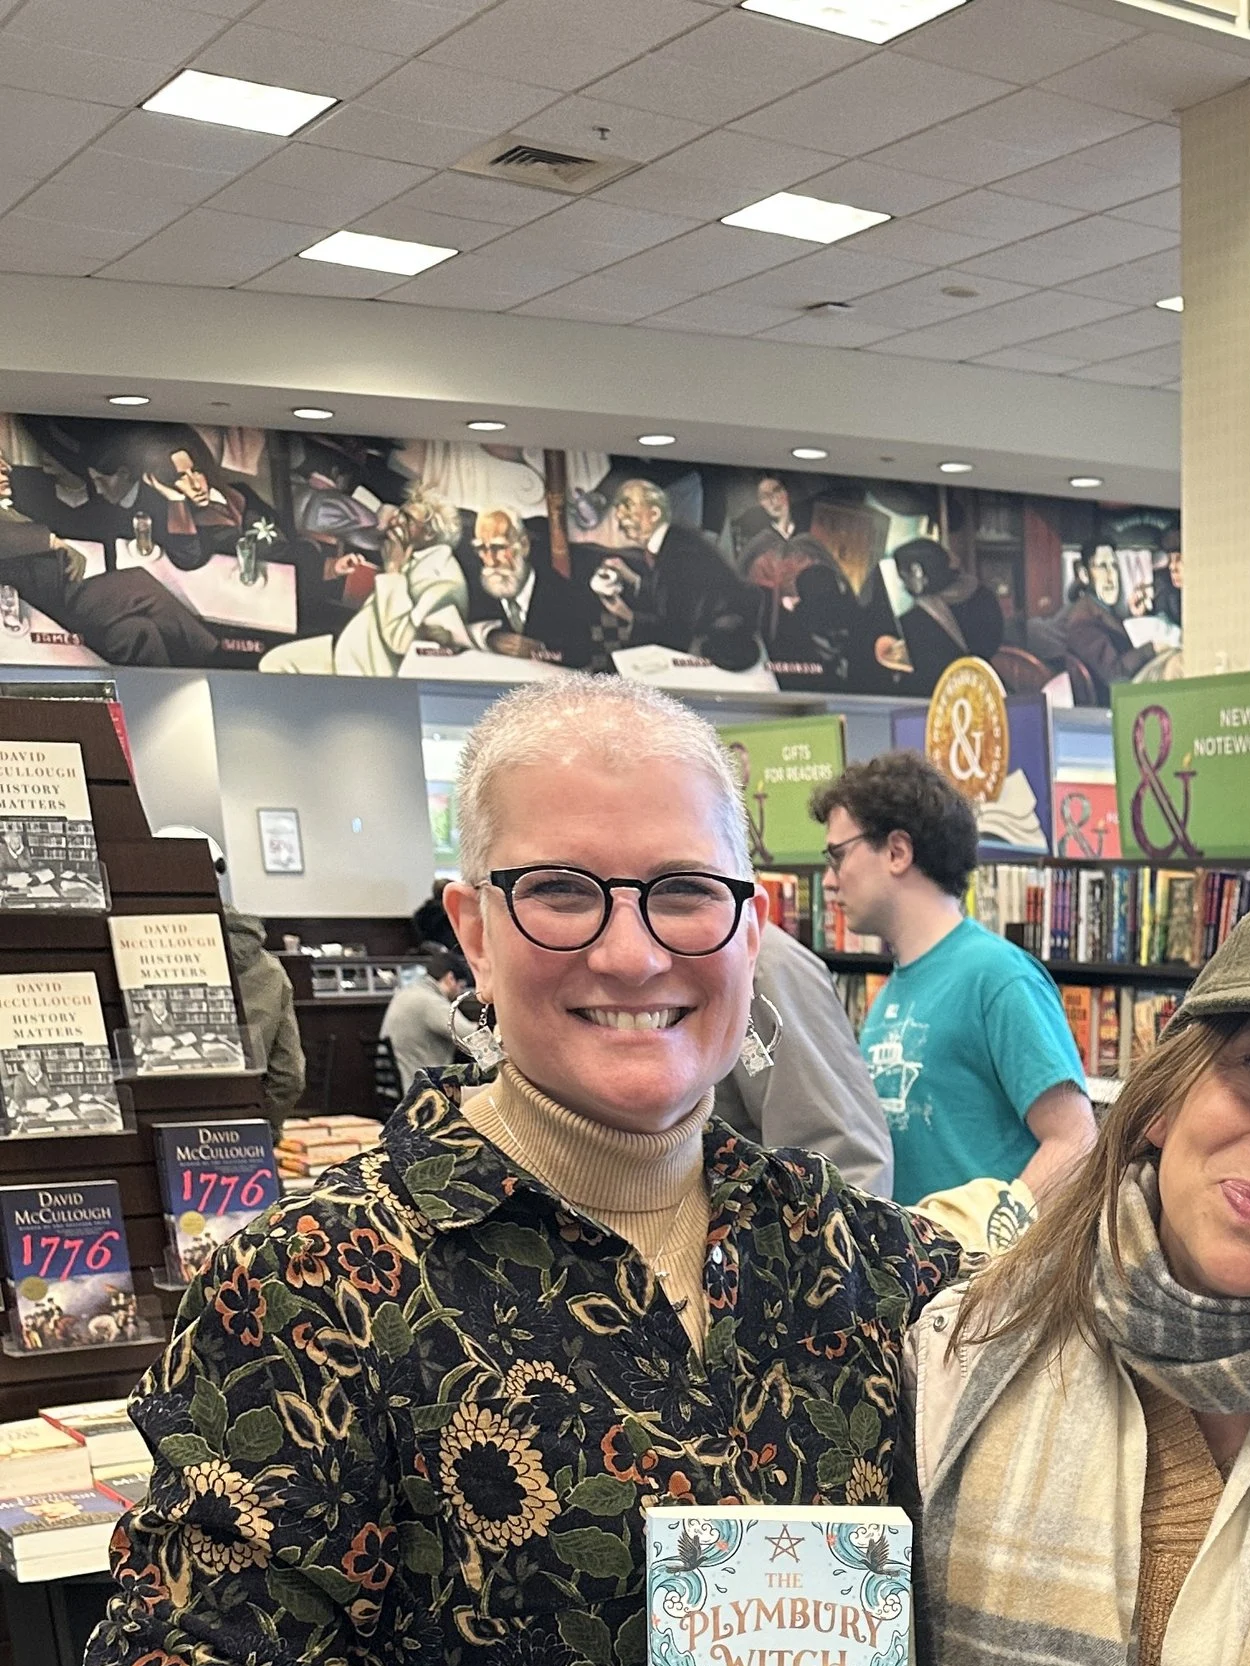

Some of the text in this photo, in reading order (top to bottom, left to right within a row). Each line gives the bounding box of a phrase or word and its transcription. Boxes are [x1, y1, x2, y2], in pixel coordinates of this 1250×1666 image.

[0, 751, 46, 762] DAVID
[781, 744, 811, 761] GIFTS
[764, 763, 833, 784] FOR READERS
[144, 924, 188, 935] DAVID
[120, 937, 217, 950] McCULLOUGH
[140, 953, 202, 966] HISTORY
[140, 967, 208, 979] MATTERS
[16, 982, 62, 993] DAVID
[12, 1012, 76, 1025] HISTORY
[13, 1027, 84, 1039] MATTERS
[182, 1168, 273, 1218] 1776
[22, 1229, 120, 1282] 1776
[764, 1572, 804, 1589] THE
[679, 1597, 888, 1652] PLYMBURY
